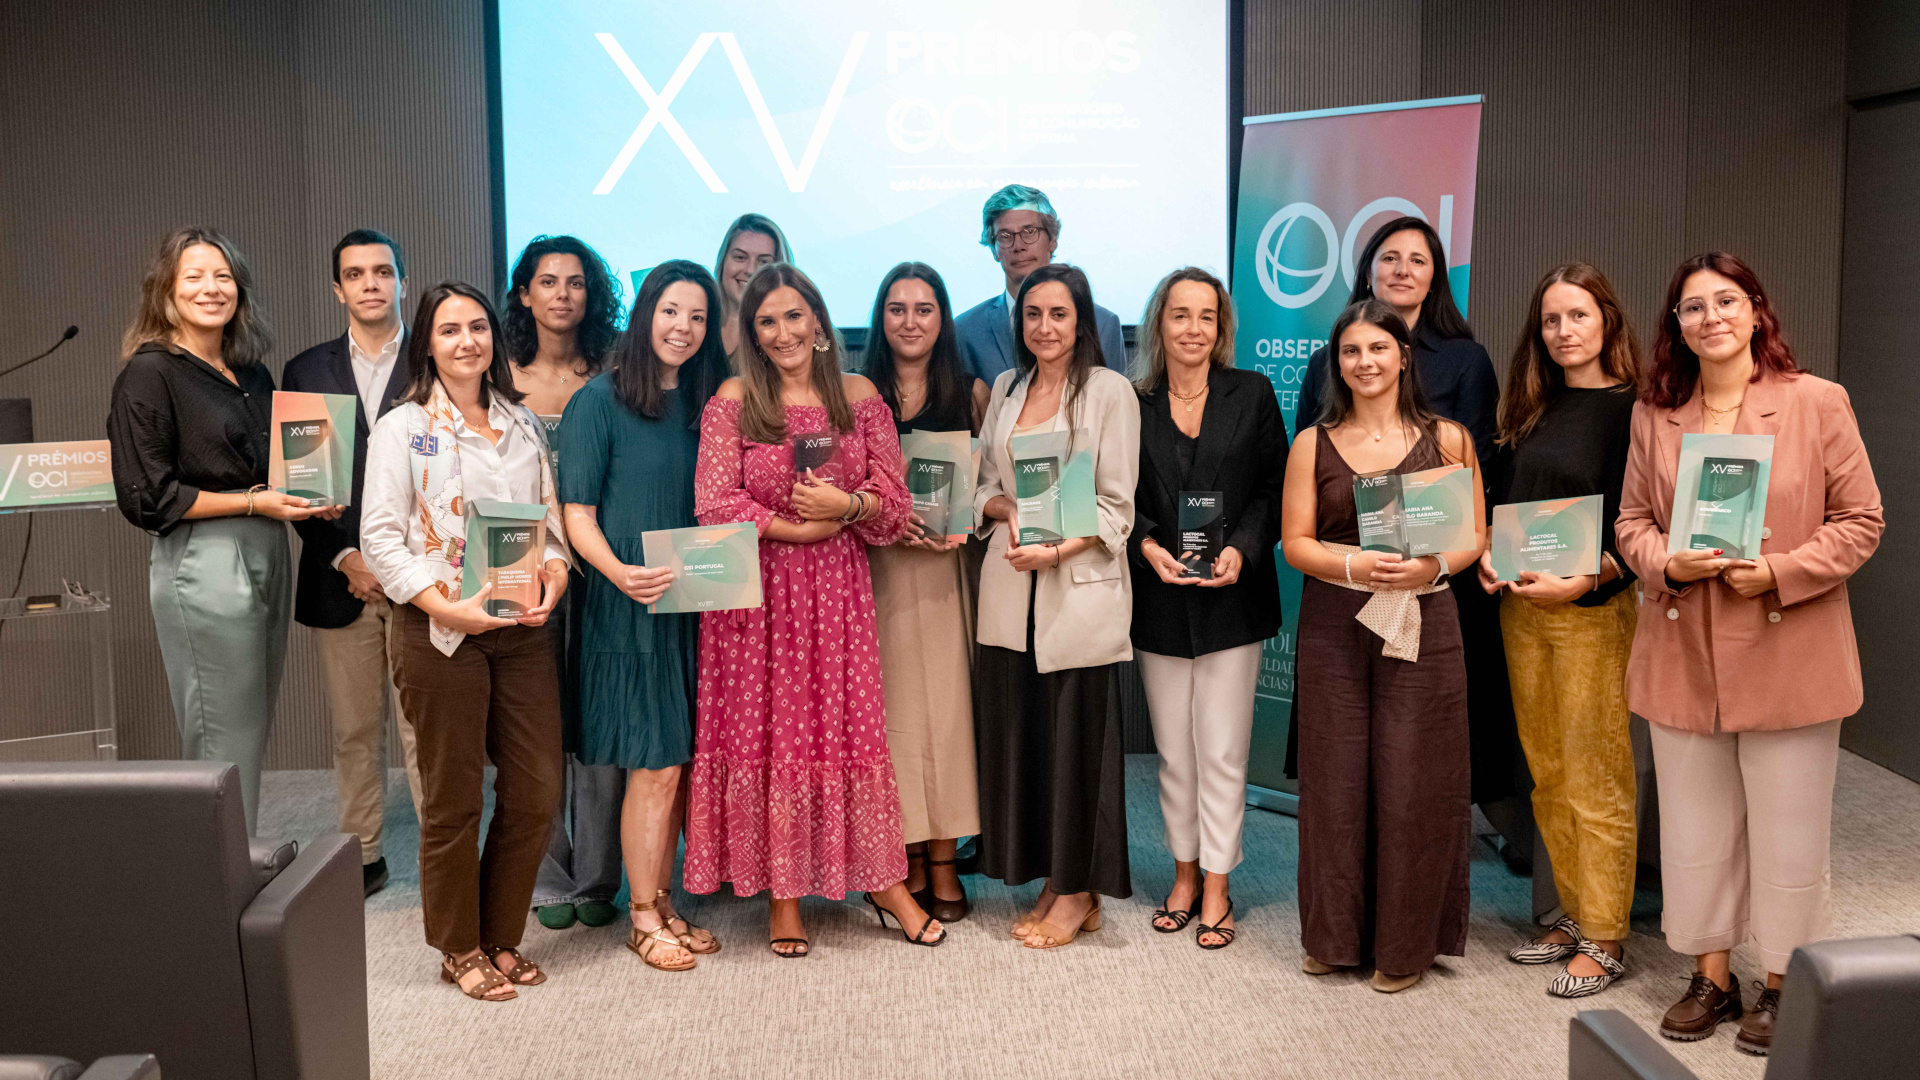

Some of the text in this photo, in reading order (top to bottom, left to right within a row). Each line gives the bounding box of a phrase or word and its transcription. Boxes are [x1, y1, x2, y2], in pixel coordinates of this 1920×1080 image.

[887, 18, 1141, 75] PRÉMIOS
[592, 31, 870, 195] XV
[290, 426, 306, 437] XV
[804, 438, 819, 449] XV
[27, 450, 108, 467] PRÉMIOS
[918, 463, 932, 473] XV
[1023, 464, 1037, 473] XV
[1710, 464, 1728, 474] XV
[28, 470, 68, 488] OCI
[1361, 478, 1375, 488] XV
[1187, 497, 1202, 507] XV
[1416, 510, 1444, 518] BARANDA
[502, 533, 517, 542] XV
